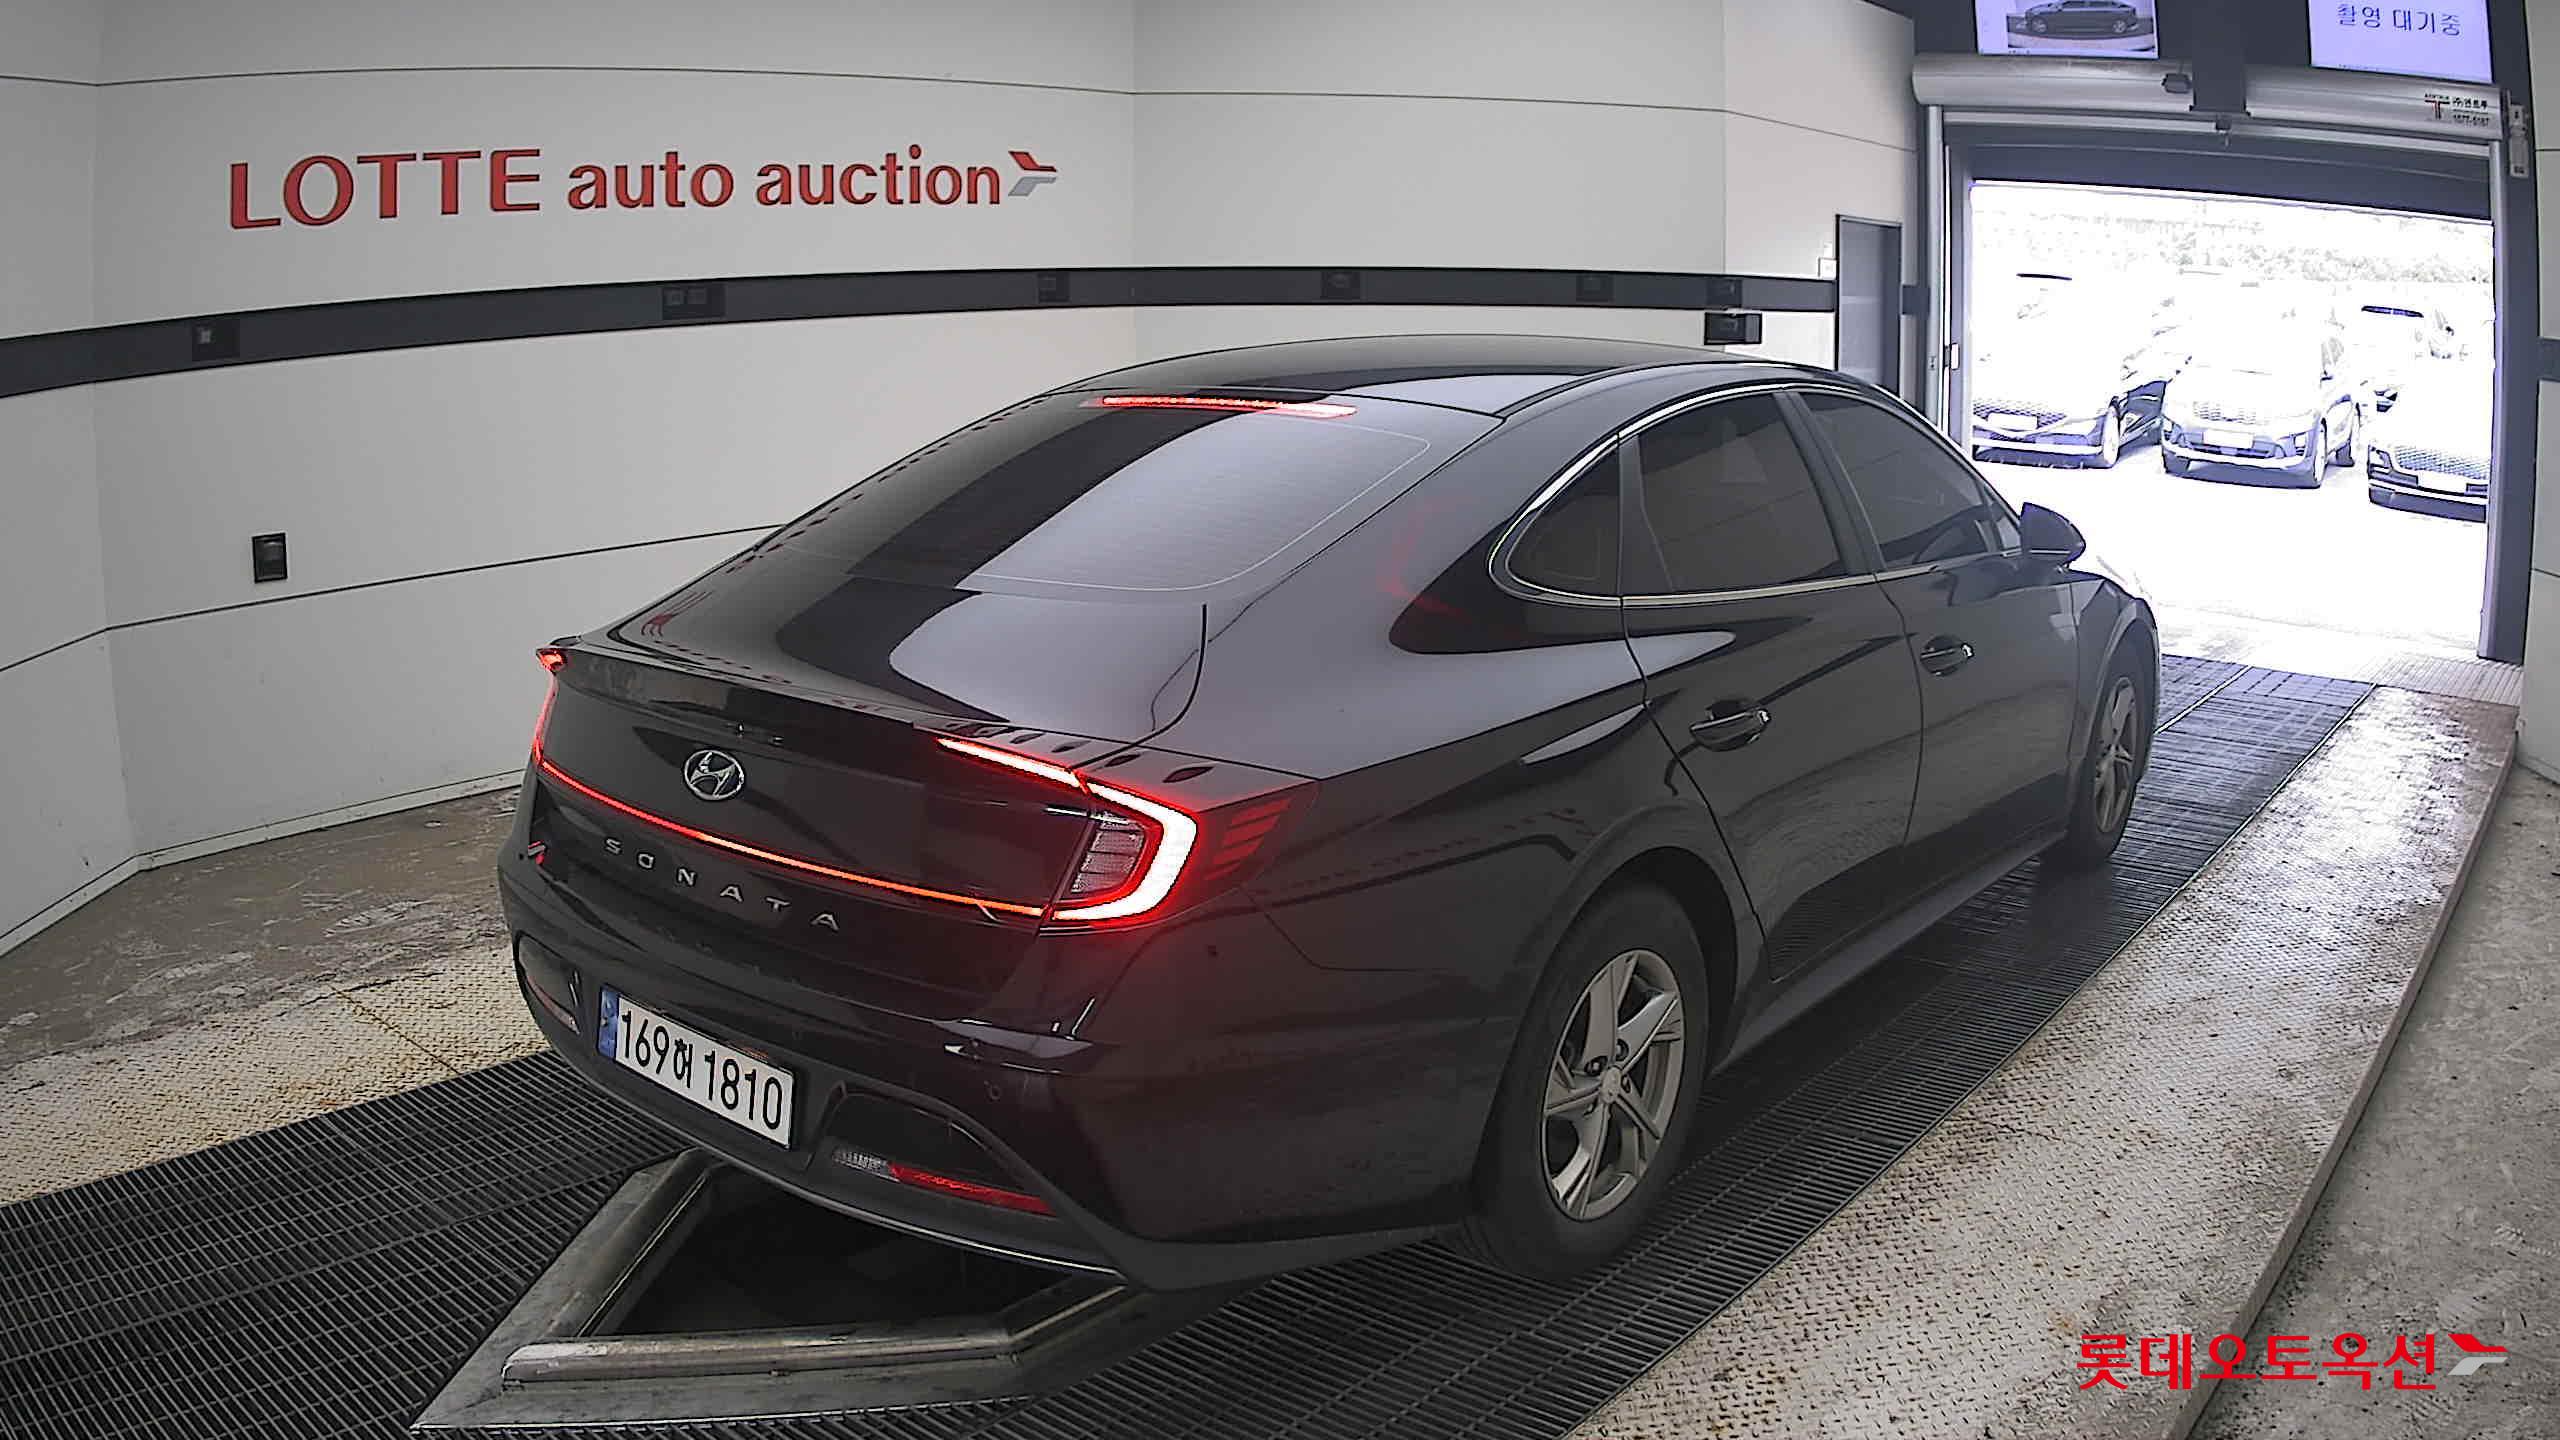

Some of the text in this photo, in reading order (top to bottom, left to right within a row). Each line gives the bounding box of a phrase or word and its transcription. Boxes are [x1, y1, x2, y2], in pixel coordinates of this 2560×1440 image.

[2338, 4, 2461, 36] 촬영 대기중
[229, 144, 1002, 229] LOTTE auto auction
[605, 838, 839, 931] SONATA
[704, 1050, 782, 1130] 1810
